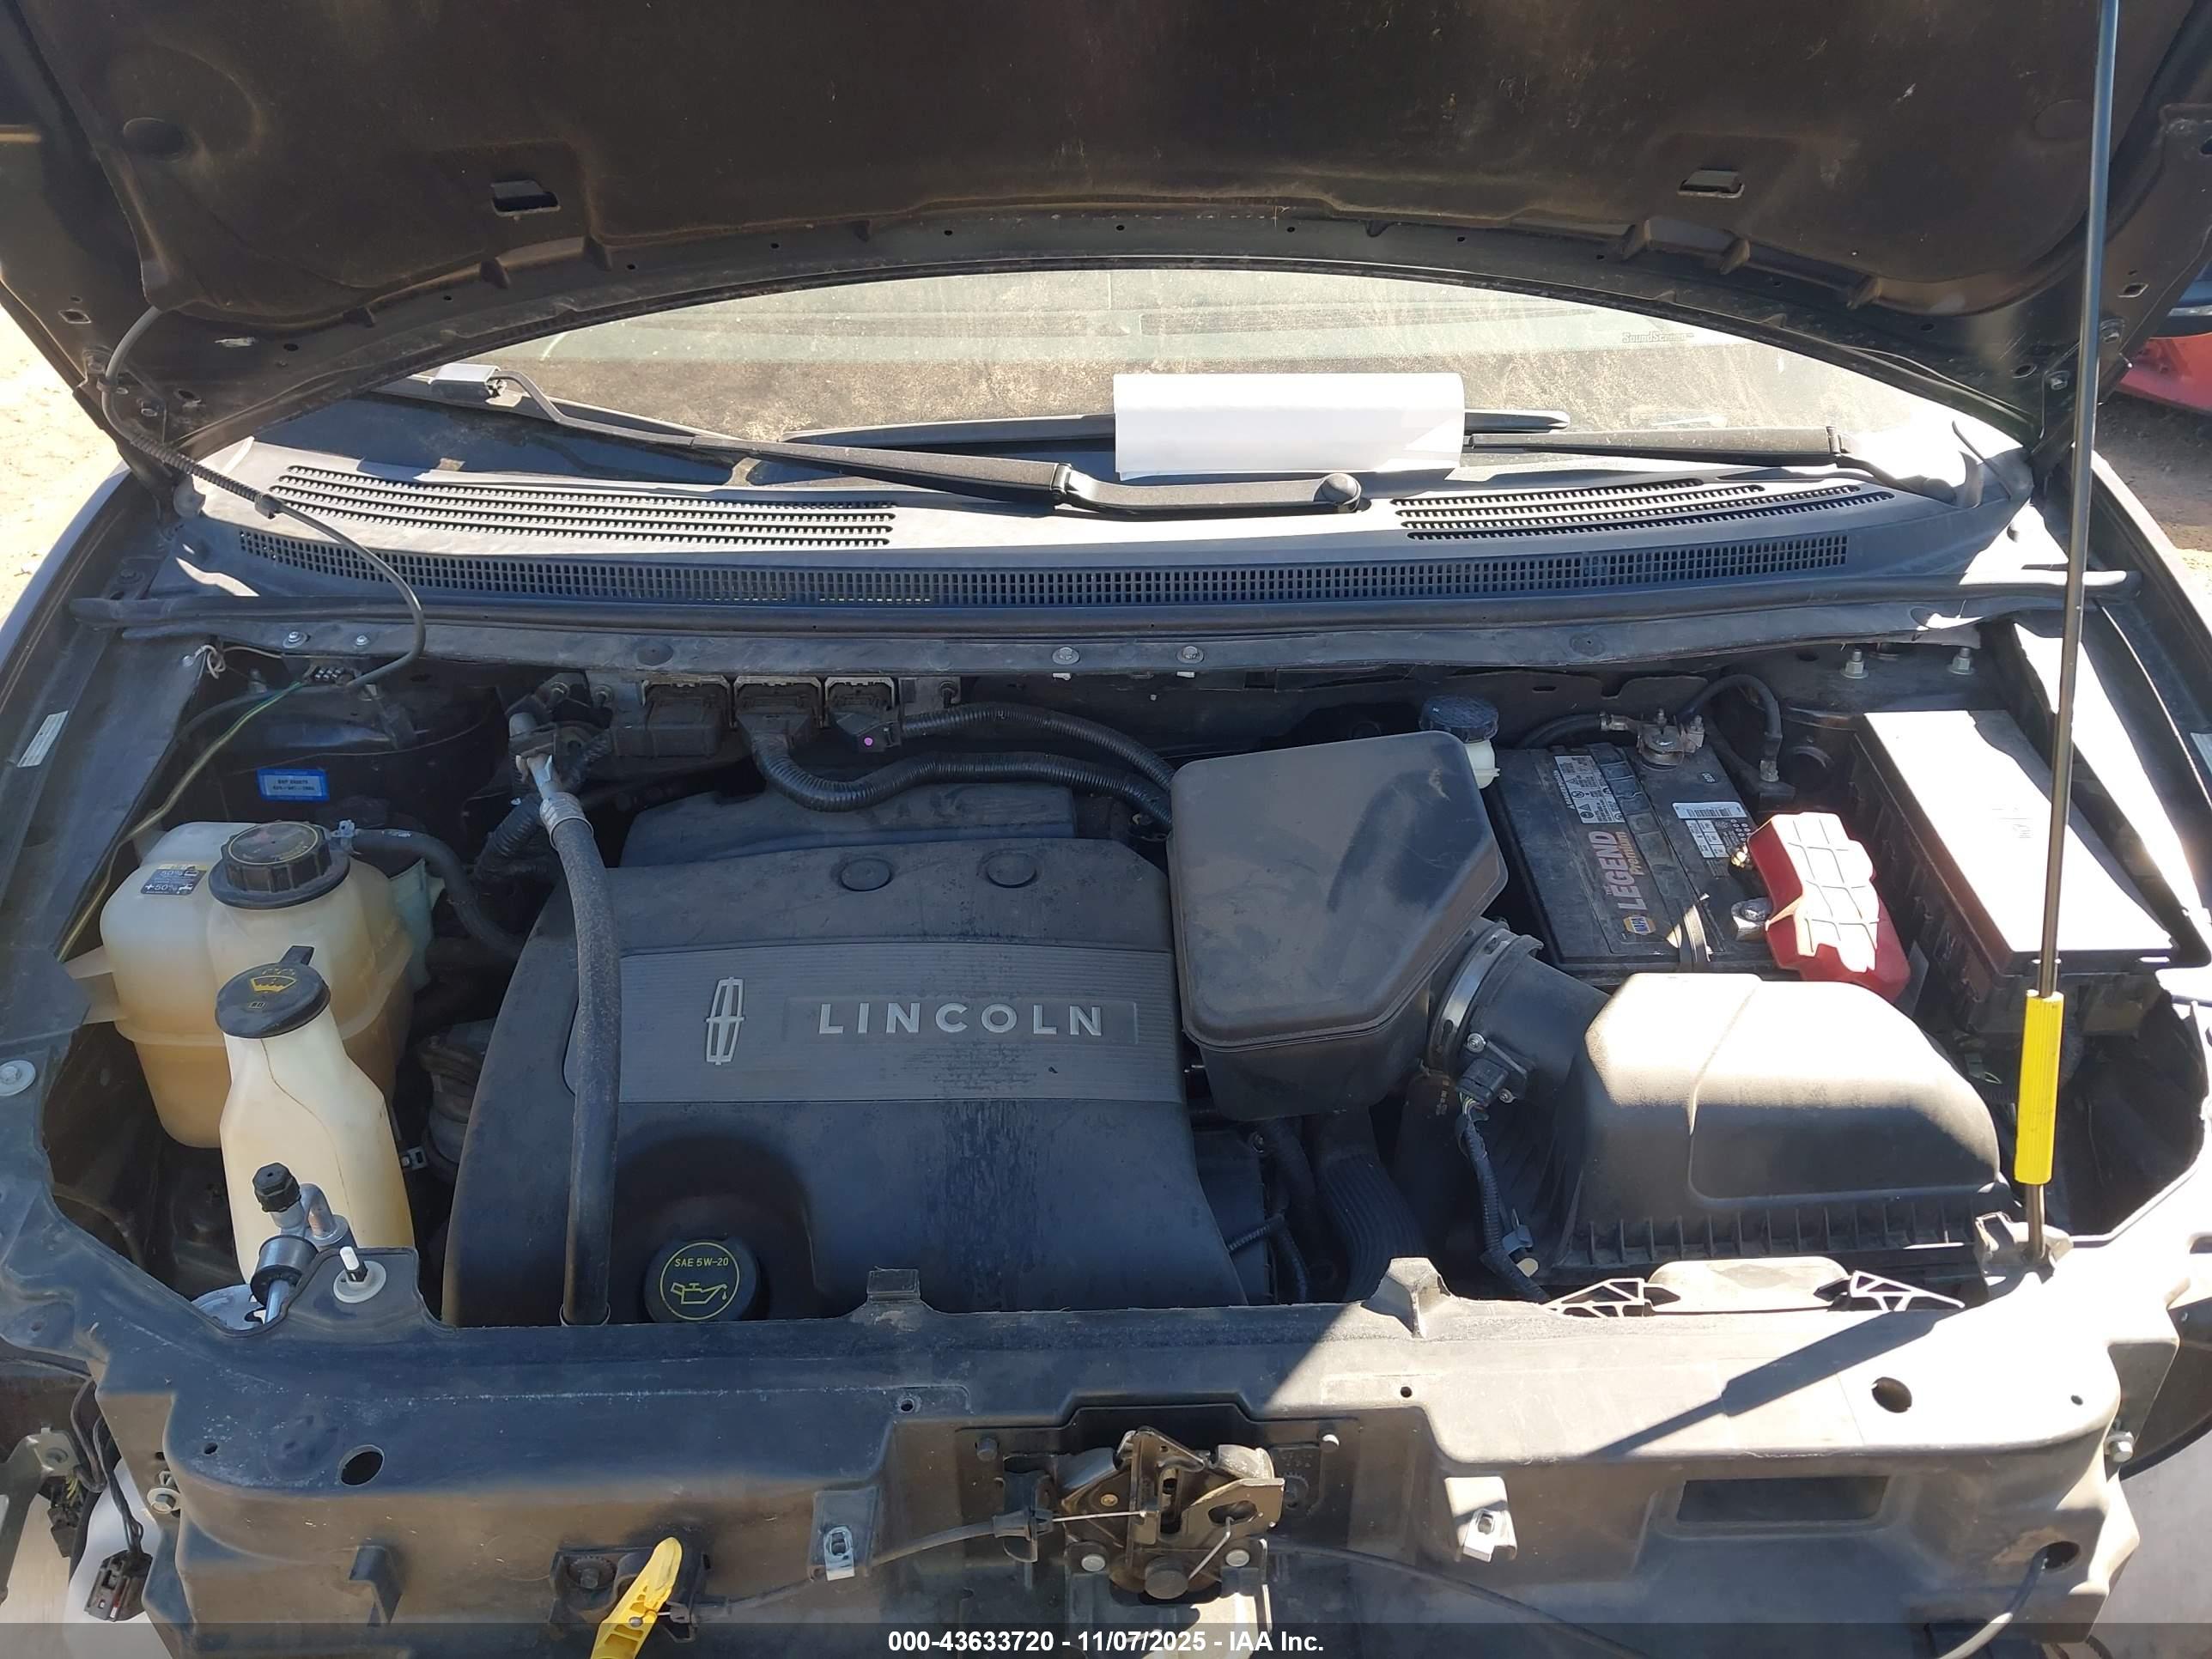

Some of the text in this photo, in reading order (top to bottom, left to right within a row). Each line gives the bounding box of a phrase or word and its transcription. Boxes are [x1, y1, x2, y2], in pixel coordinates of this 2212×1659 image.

[1589, 830, 1648, 910] LEGEND
[1615, 831, 1645, 875] Premium
[1631, 915, 1650, 933] NAPA
[818, 1002, 1102, 1036] LINCOLN
[674, 1257, 729, 1267] SAE 5W-20
